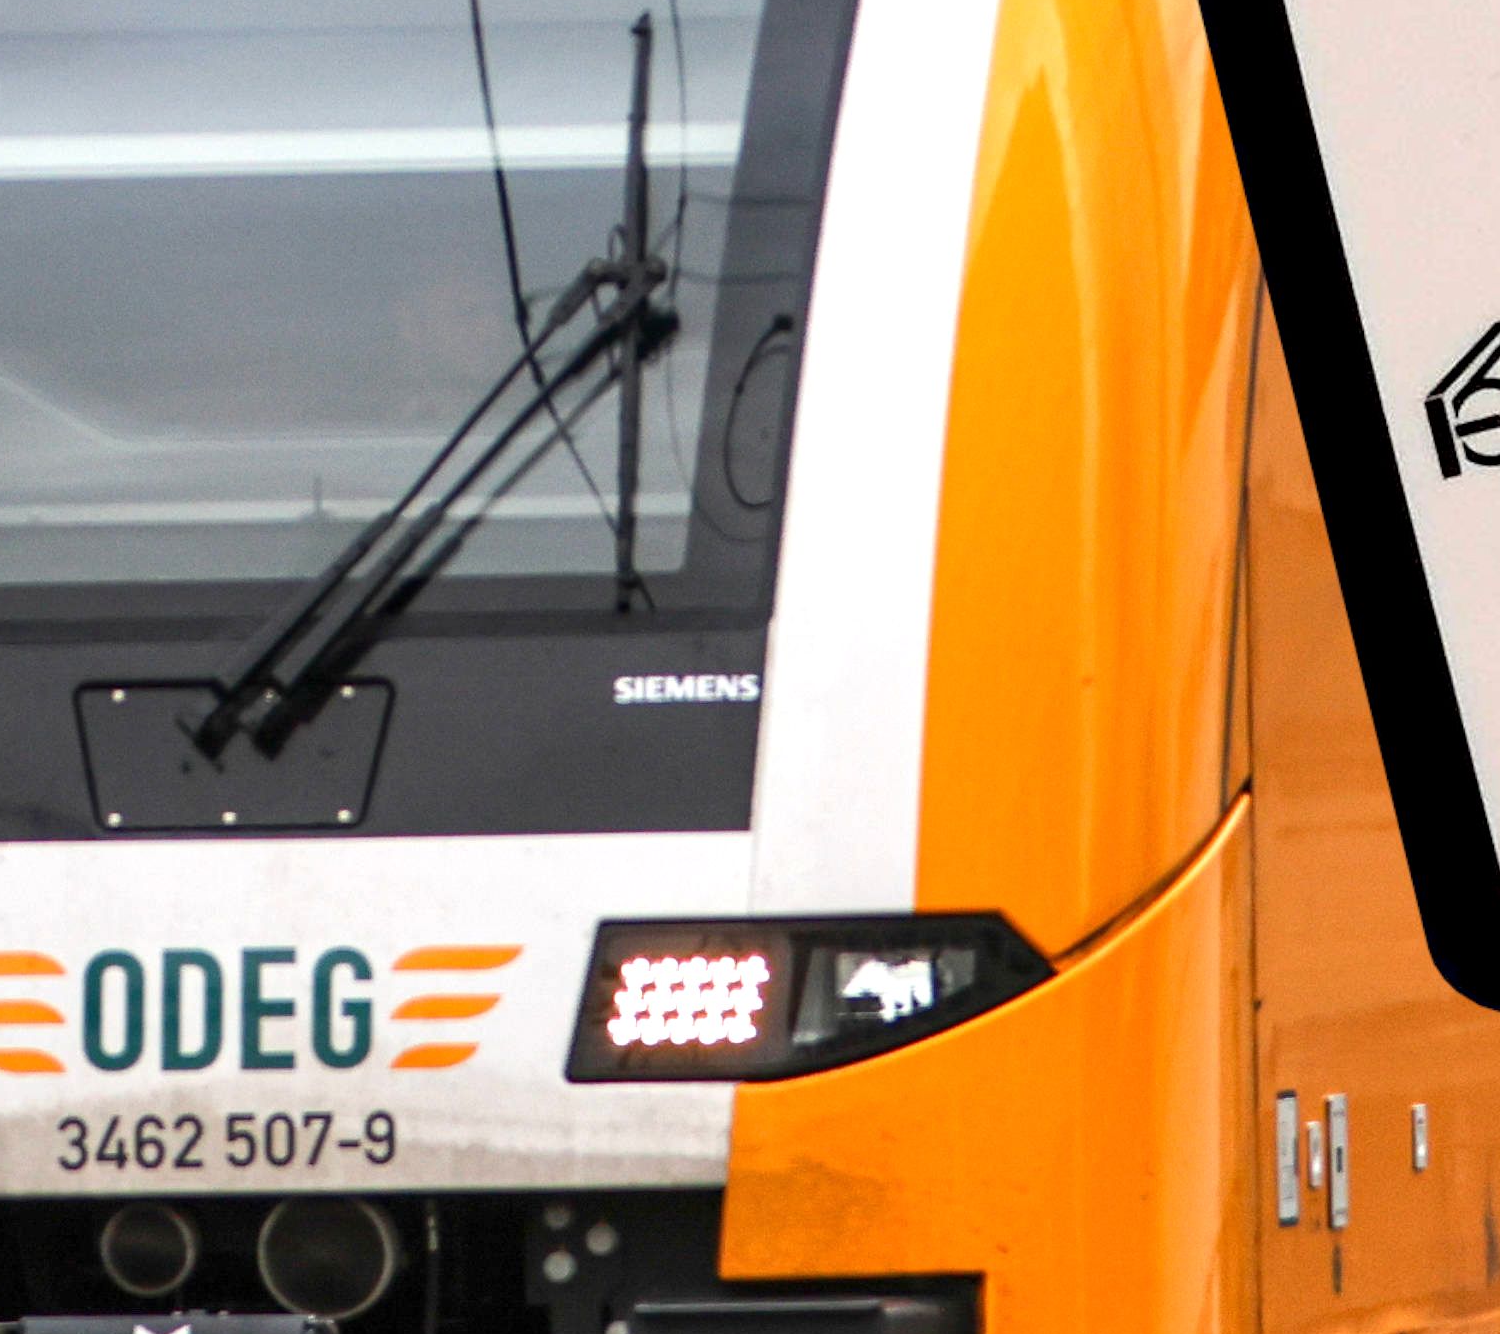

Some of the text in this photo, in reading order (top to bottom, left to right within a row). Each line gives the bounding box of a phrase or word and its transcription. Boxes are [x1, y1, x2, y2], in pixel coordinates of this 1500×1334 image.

[612, 673, 760, 704] SIEMENS
[83, 948, 373, 1072] ODEG
[57, 1110, 396, 1172] 3462 507-9
